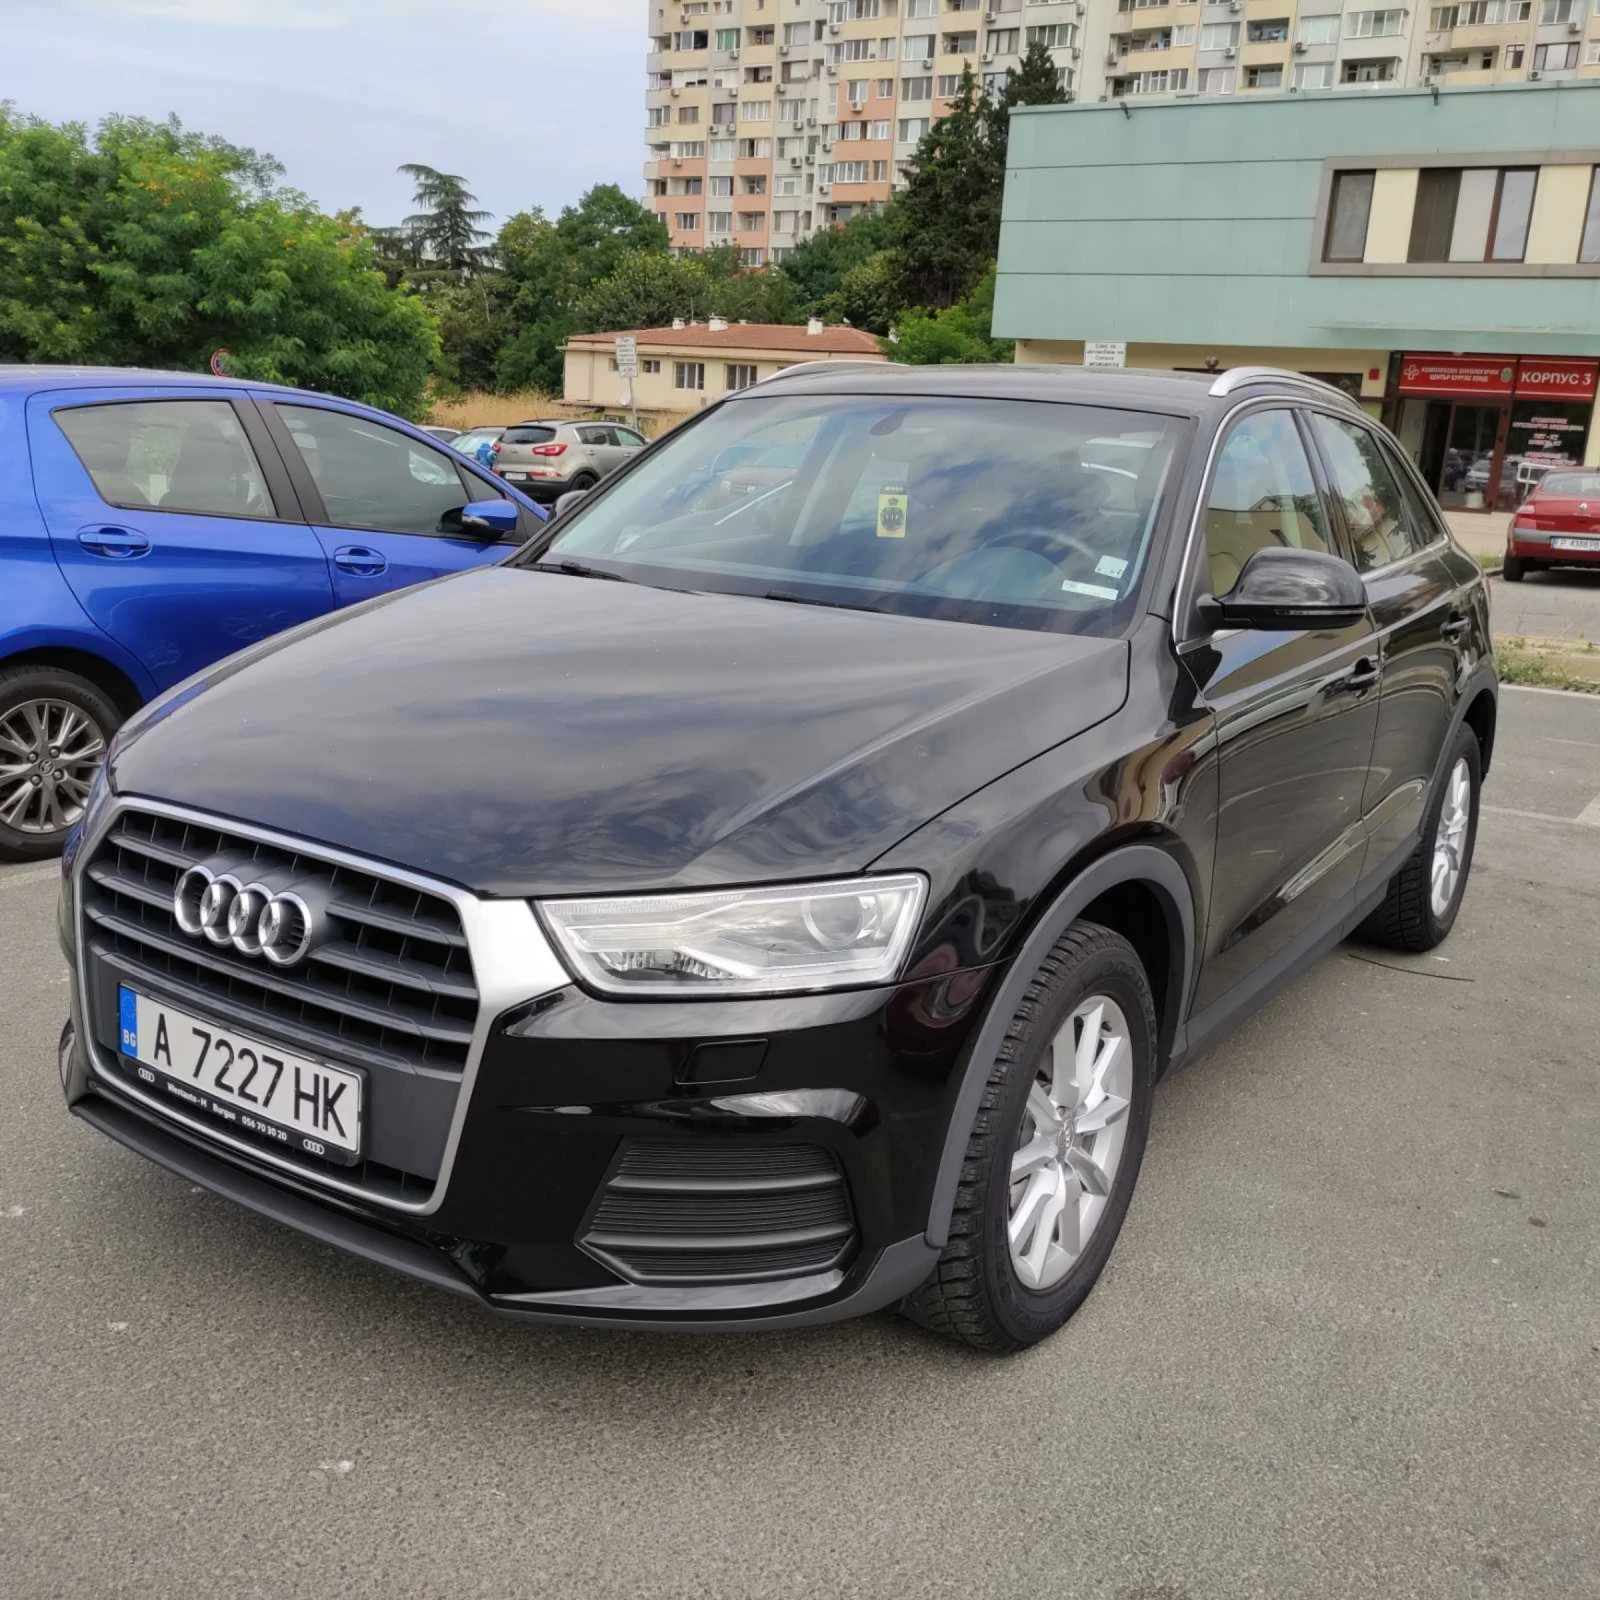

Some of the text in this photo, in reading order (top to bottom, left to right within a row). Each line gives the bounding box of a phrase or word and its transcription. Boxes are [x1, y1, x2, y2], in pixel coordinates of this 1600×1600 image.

[1521, 372, 1592, 386] КОРПУС 3
[123, 1028, 136, 1047] BG
[154, 1013, 348, 1138] A 7227 HK
[212, 1103, 236, 1120] Burgas
[242, 1115, 255, 1129] 056
[256, 1121, 266, 1132] 70
[267, 1125, 276, 1136] 30
[278, 1129, 288, 1141] 20
